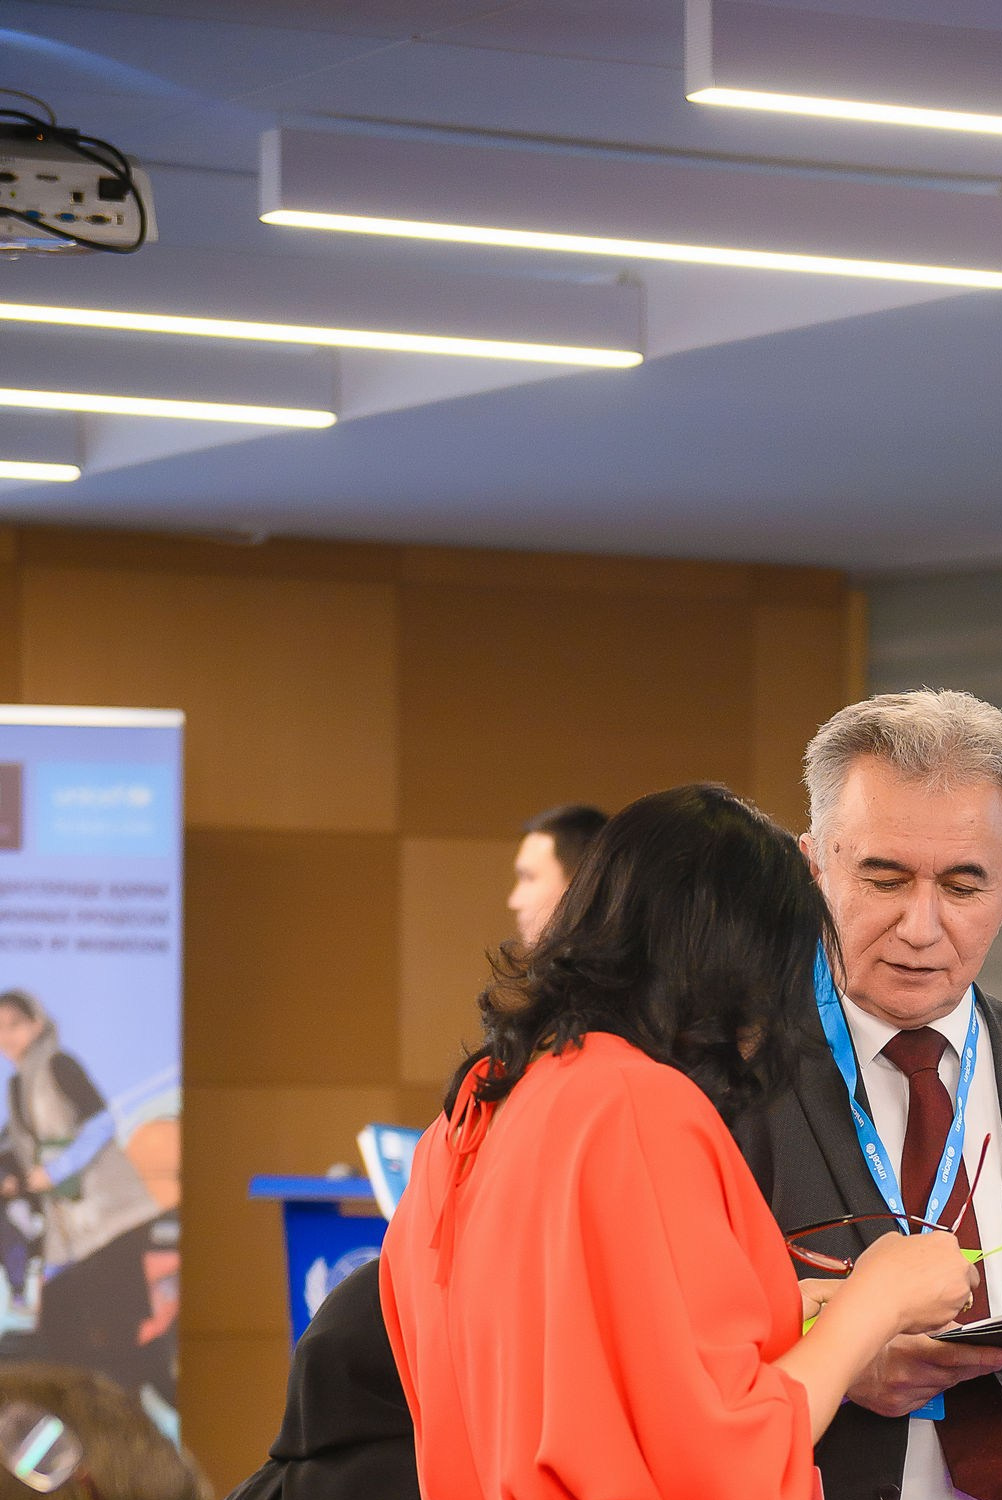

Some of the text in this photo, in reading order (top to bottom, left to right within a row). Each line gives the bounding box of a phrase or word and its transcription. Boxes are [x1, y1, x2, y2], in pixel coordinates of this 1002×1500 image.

[963, 1056, 972, 1083] unicef
[868, 1153, 888, 1180] unicef
[941, 1154, 954, 1184] unicef
